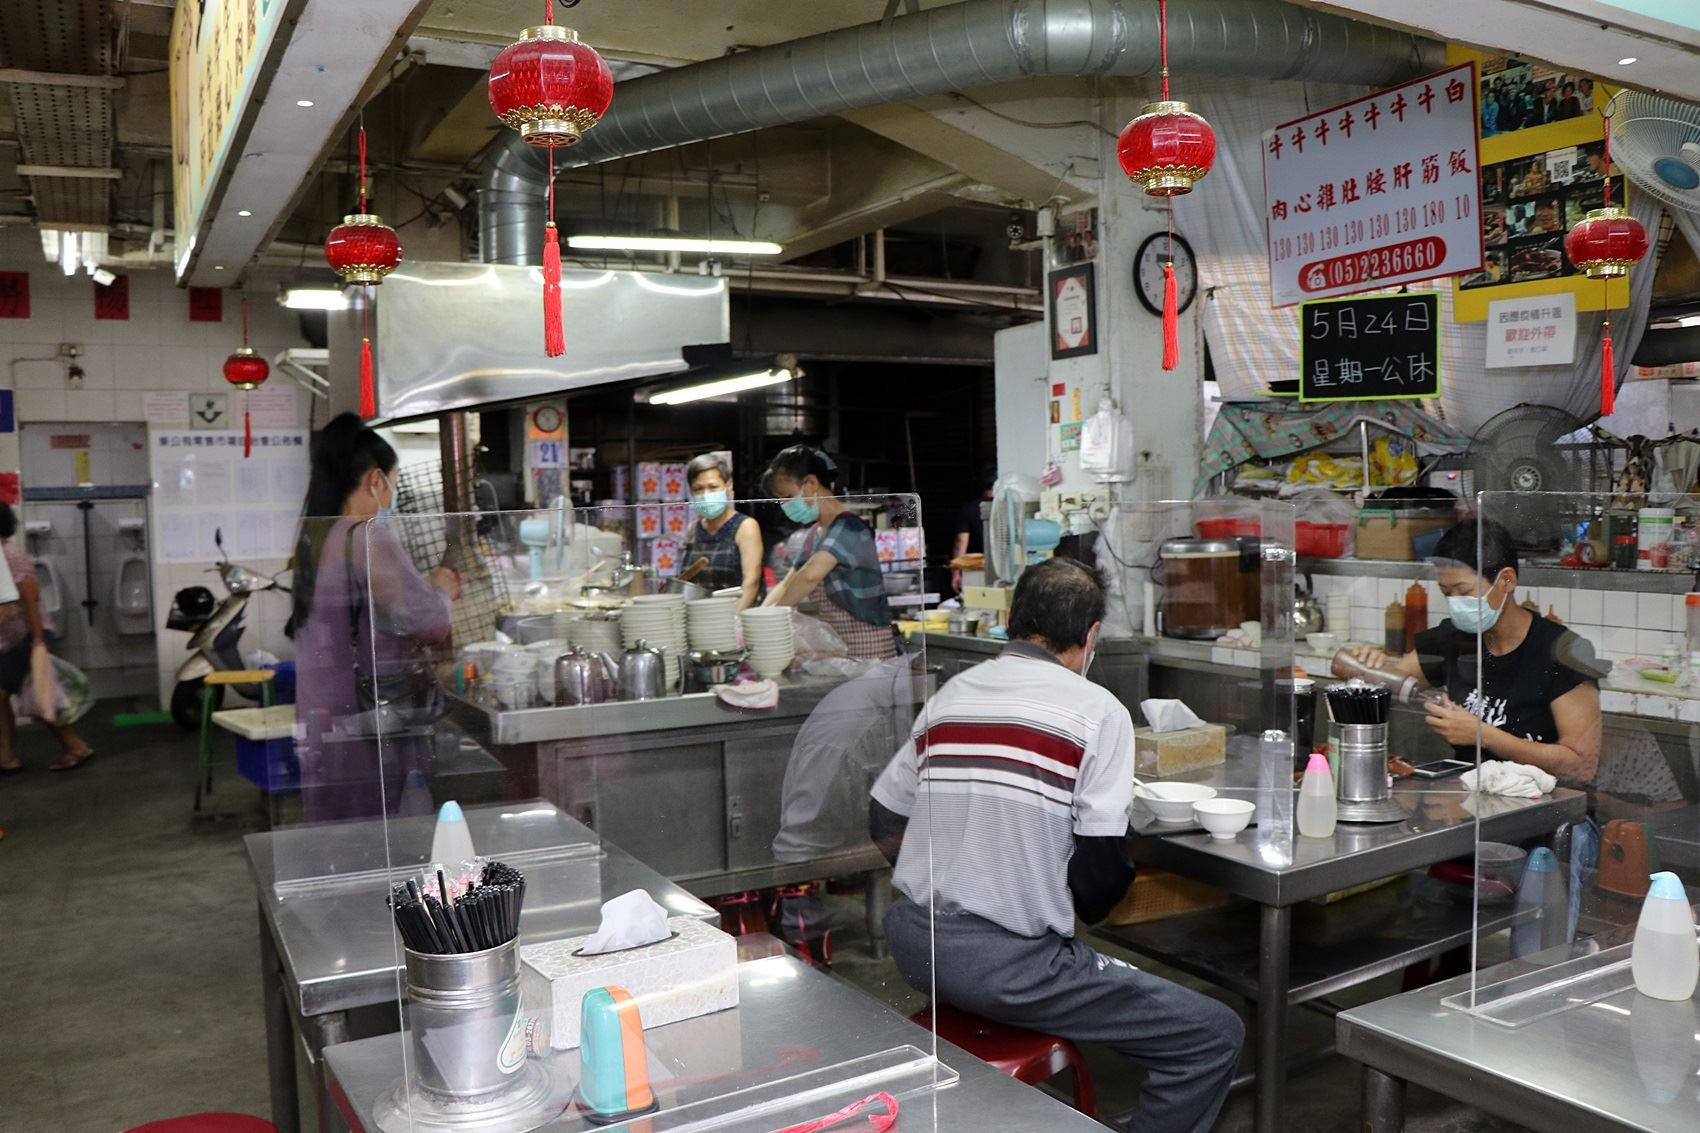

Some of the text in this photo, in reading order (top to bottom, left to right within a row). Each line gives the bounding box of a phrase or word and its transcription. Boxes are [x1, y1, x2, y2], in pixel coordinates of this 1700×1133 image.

[1423, 199, 1445, 228] 180
[1455, 193, 1471, 220] 10
[1345, 219, 1364, 246] 130
[1370, 213, 1390, 240] 130
[1396, 207, 1416, 234] 130
[1273, 238, 1292, 262] 130
[1296, 232, 1315, 256] 130
[1320, 226, 1339, 251] 130
[1329, 241, 1437, 286] (05)2236660
[1311, 302, 1431, 340] 5月24日
[1312, 352, 1434, 387] 星期一公休
[539, 441, 559, 464] 21
